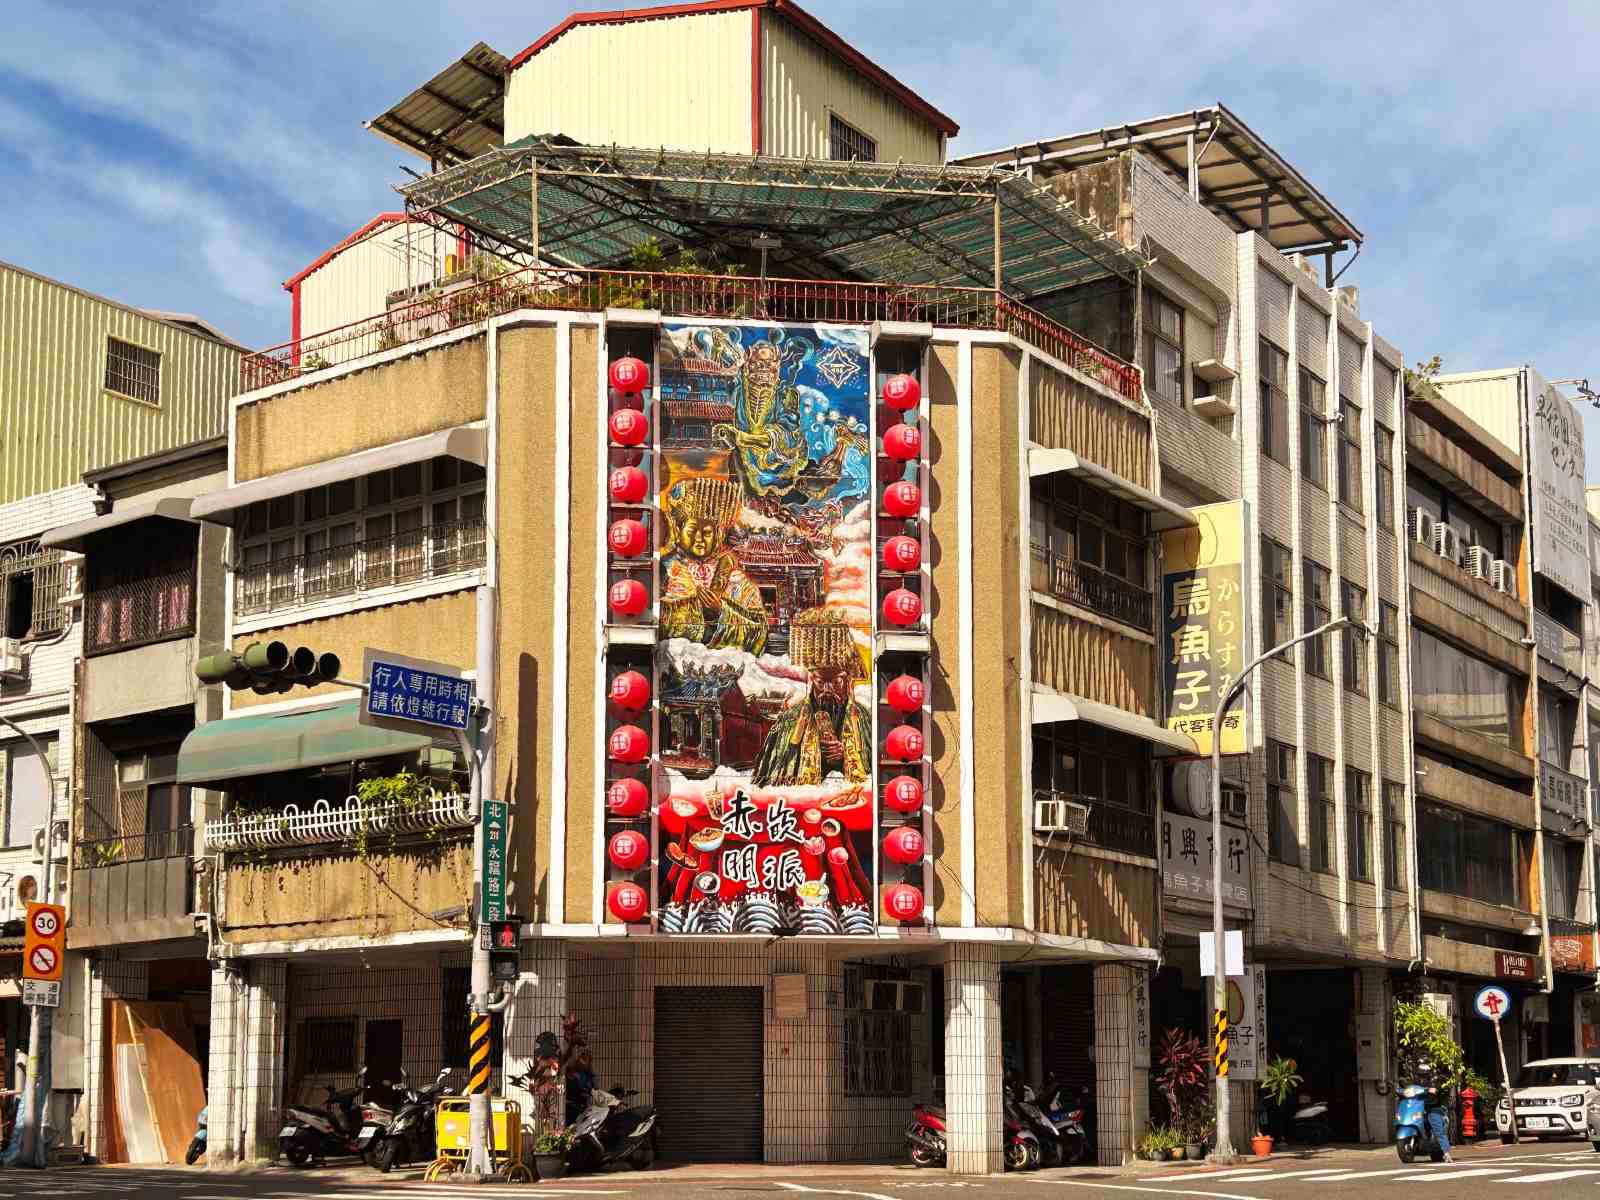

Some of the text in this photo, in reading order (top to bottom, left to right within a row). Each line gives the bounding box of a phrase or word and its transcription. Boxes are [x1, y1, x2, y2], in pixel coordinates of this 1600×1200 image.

[1169, 577, 1211, 712] 烏魚子
[1216, 576, 1241, 699] からすみ
[374, 665, 469, 702] 行人專用時相
[371, 690, 466, 725] 請依燈號行駛
[489, 803, 501, 818] 北
[38, 917, 55, 930] 30
